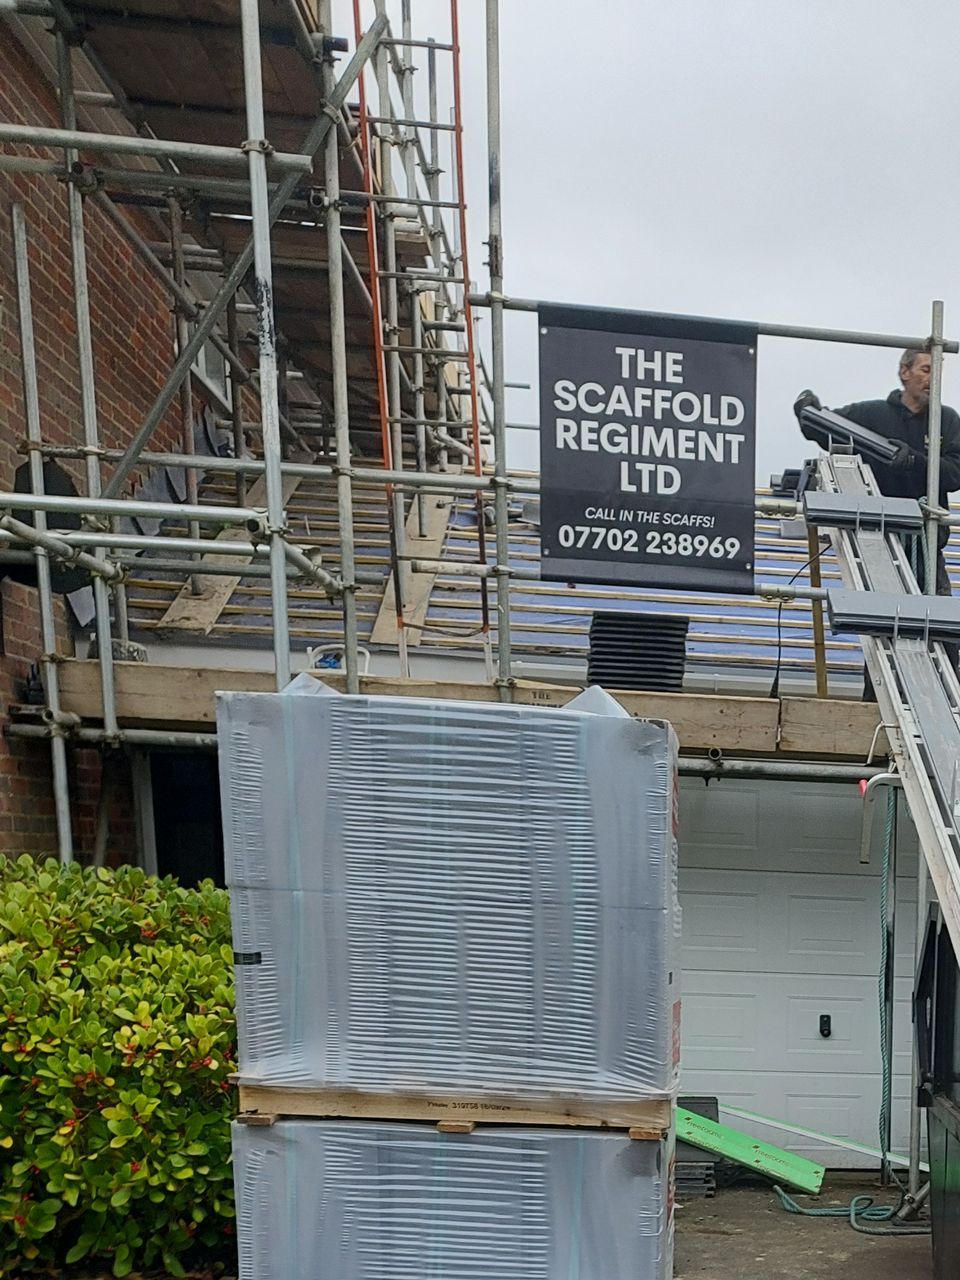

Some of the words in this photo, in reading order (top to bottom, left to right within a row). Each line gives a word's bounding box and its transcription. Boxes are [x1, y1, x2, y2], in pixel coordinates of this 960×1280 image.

[615, 346, 684, 384] THE
[553, 379, 745, 427] SCAFFOLD
[555, 418, 745, 464] REGIMENT
[620, 461, 682, 495] LTD
[584, 507, 617, 521] CALL
[619, 509, 635, 522] IN
[637, 511, 661, 524] THE
[662, 513, 716, 528] SCAFFS!
[558, 525, 639, 552] 07702
[646, 531, 741, 559] 238969
